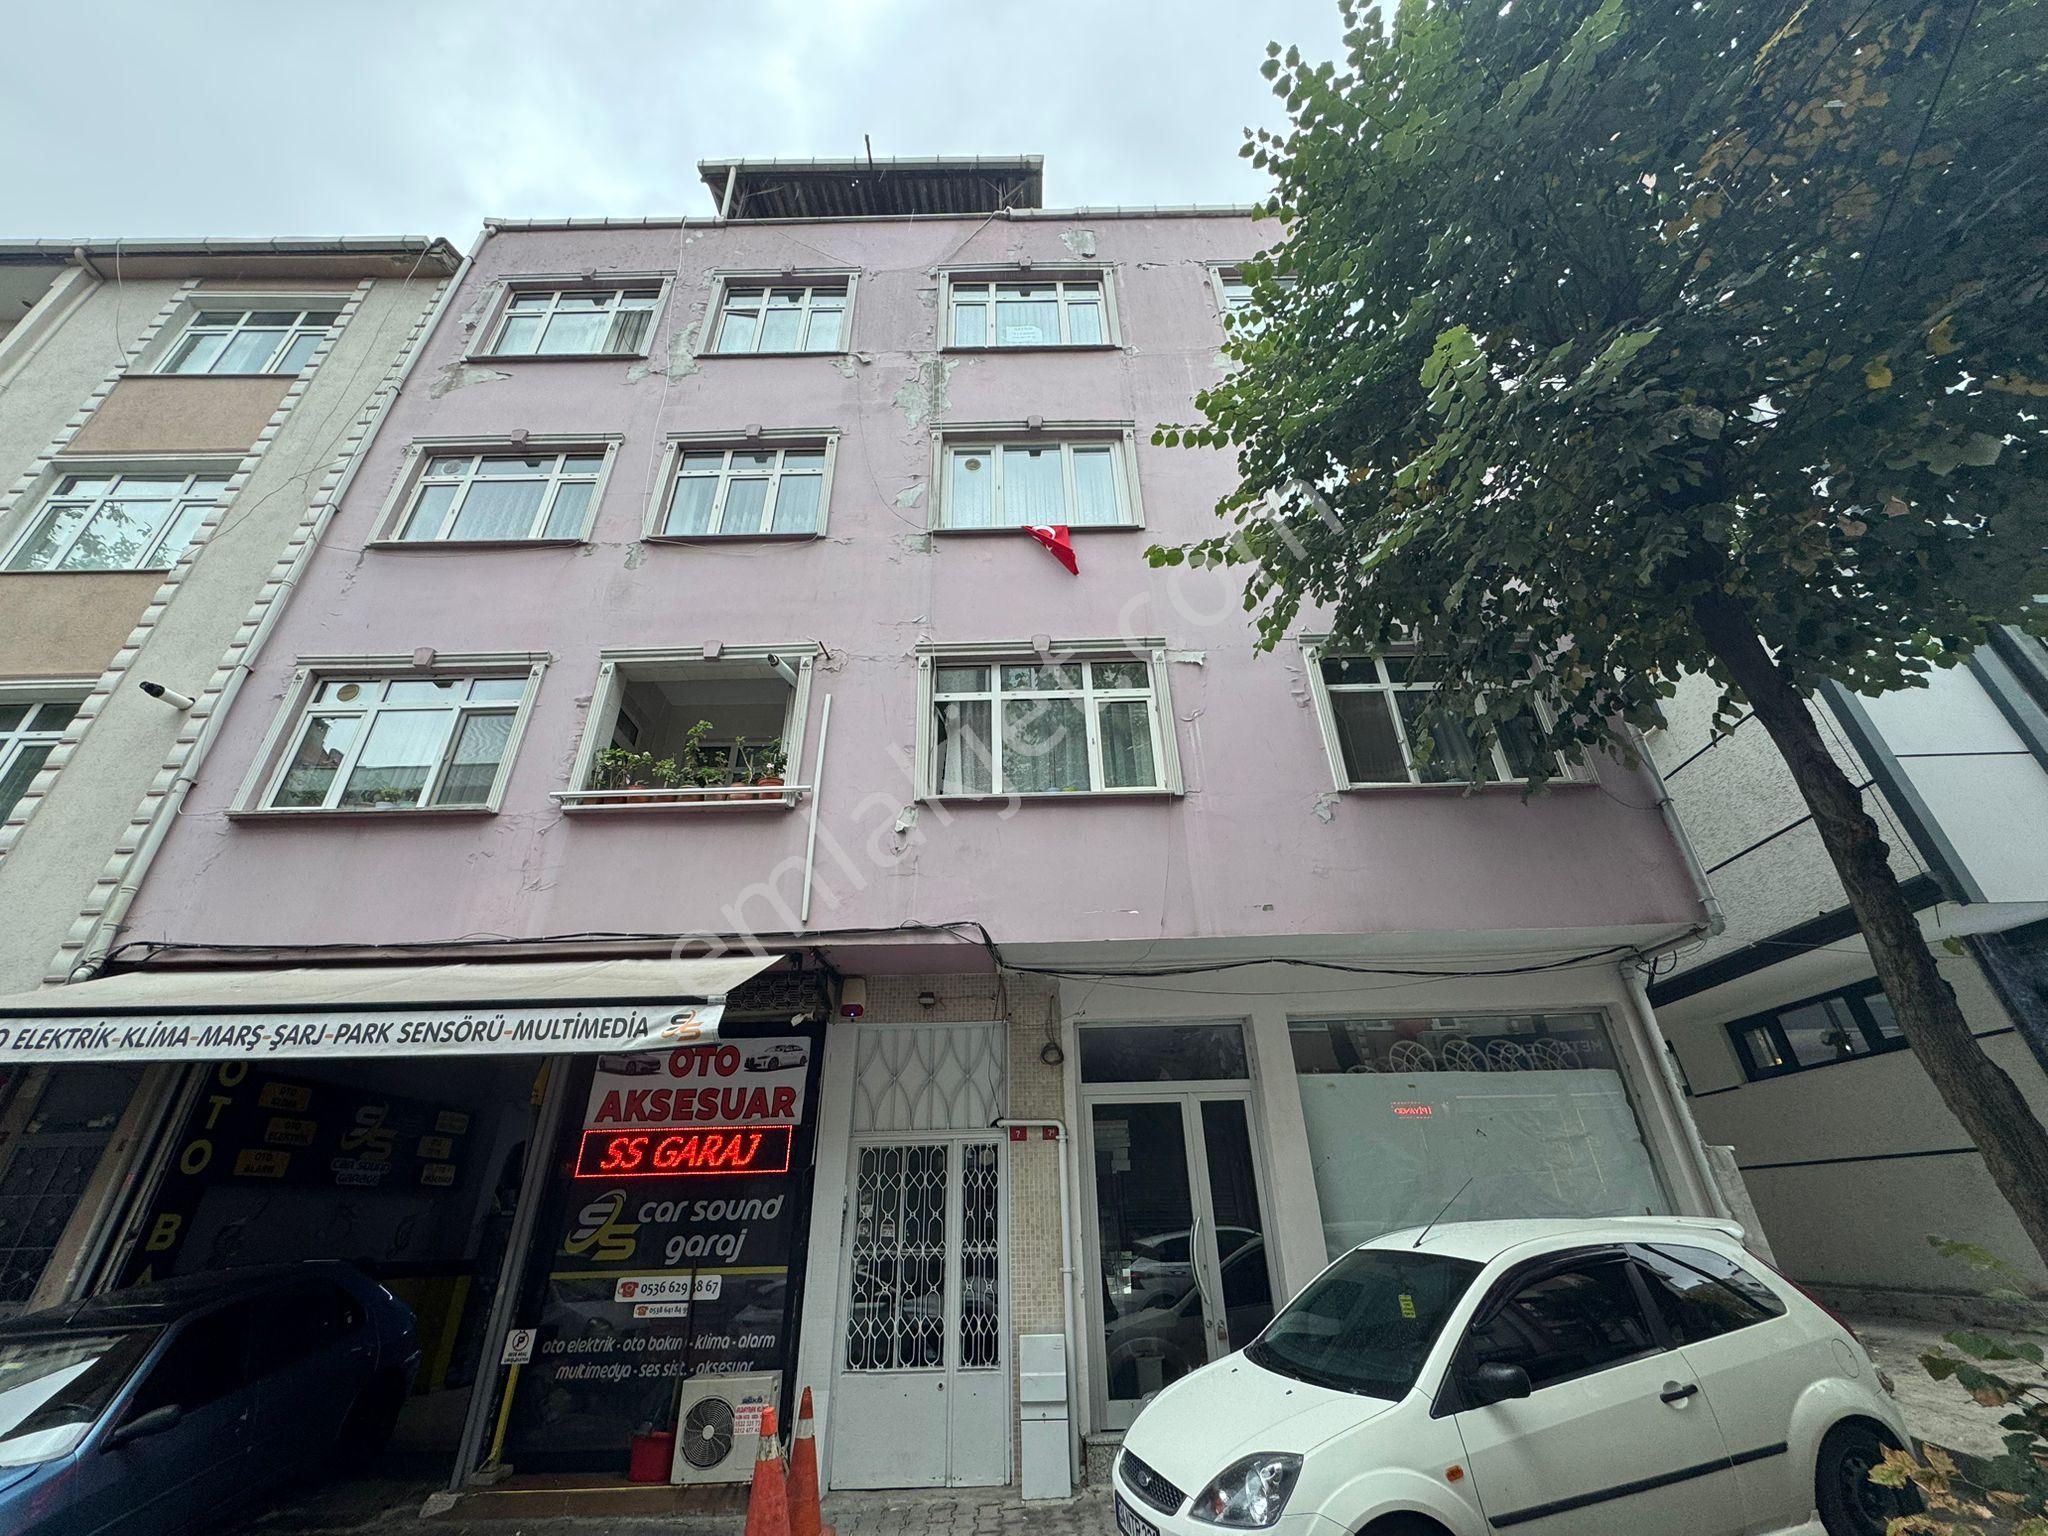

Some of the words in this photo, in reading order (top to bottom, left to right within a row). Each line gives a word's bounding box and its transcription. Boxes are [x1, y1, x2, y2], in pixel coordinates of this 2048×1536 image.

[668, 1045, 741, 1078] OTO
[594, 1086, 797, 1123] AKSESUAR
[600, 1137, 649, 1169] SS
[653, 1134, 763, 1168] GARAJ
[637, 1199, 689, 1224] car
[689, 1195, 785, 1223] sound
[664, 1228, 749, 1266] garaj
[640, 1281, 667, 1296] 0536
[668, 1281, 688, 1296] 629
[705, 1280, 719, 1294] 67
[542, 1339, 565, 1354] oto
[567, 1336, 617, 1353] elektrik
[622, 1337, 645, 1352] oto
[695, 1333, 730, 1349] klima
[738, 1333, 776, 1349] alarm
[555, 1362, 632, 1382] multimedya
[638, 1363, 661, 1377] ses
